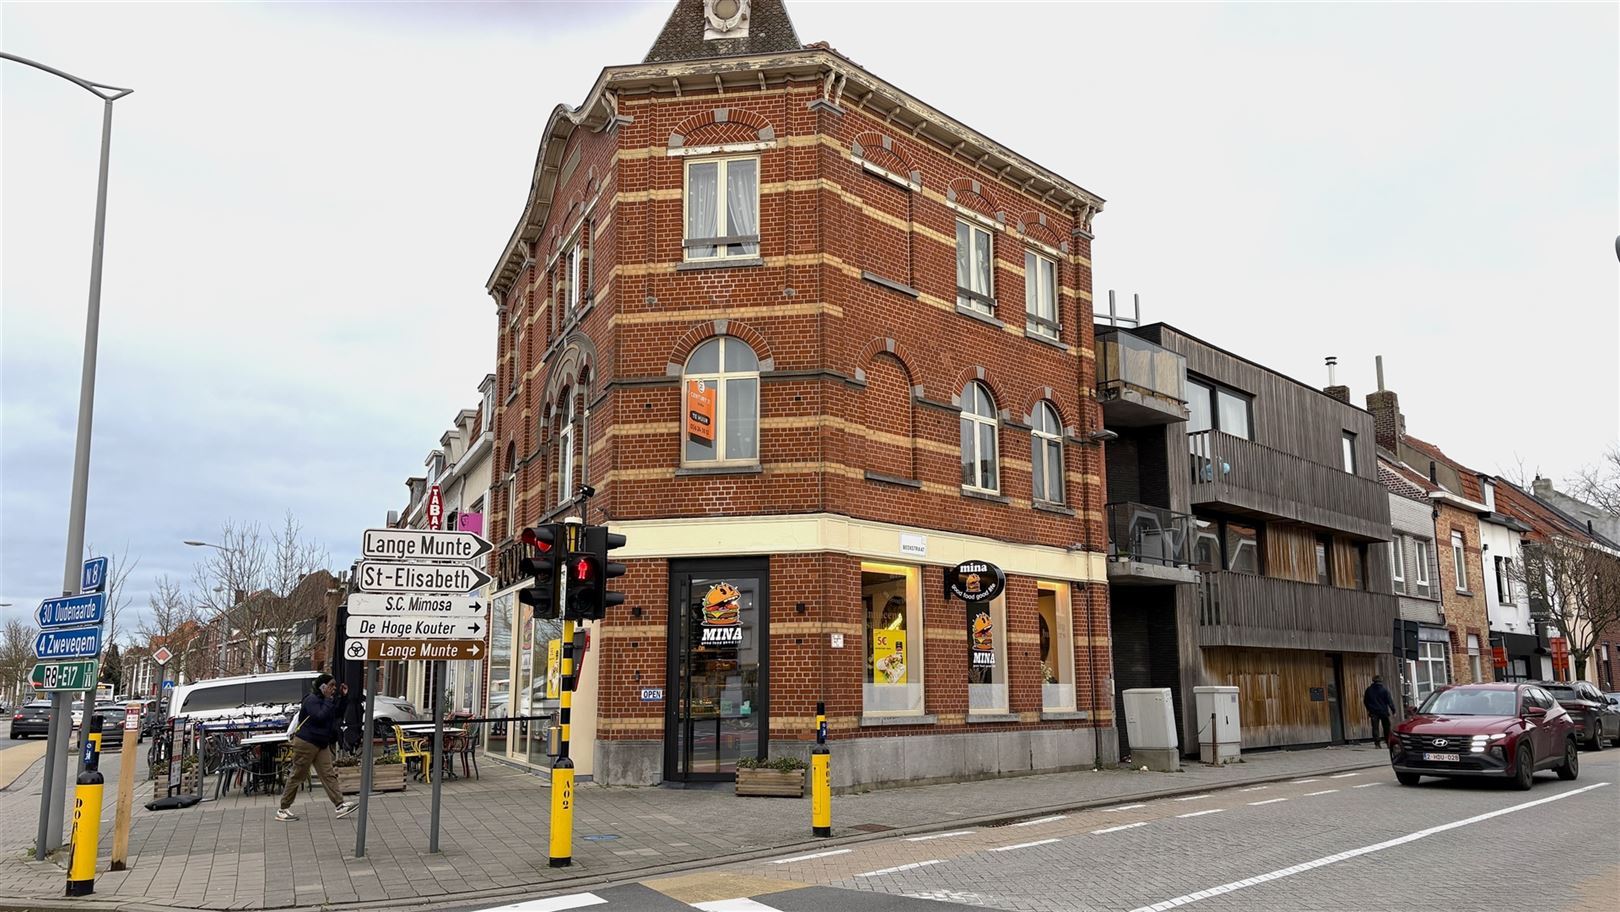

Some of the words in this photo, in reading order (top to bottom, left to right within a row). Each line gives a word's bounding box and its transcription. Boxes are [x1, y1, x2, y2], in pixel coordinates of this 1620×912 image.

[366, 534, 415, 558] Lange
[421, 536, 472, 556] Munte
[86, 569, 92, 585] N
[92, 563, 98, 584] 8
[960, 562, 987, 573] mina
[364, 566, 469, 589] St-Elisabeth
[951, 583, 963, 597] good
[963, 592, 975, 600] food
[975, 589, 989, 600] good
[42, 604, 51, 623] 30
[55, 599, 96, 622] Oudenaarde
[385, 597, 405, 611] S.C.
[408, 597, 452, 611] Mimosa
[360, 620, 375, 634] De
[381, 620, 411, 637] Hoge
[415, 621, 456, 634] Kouter
[701, 627, 743, 641] MINA
[39, 636, 45, 653] 4
[48, 634, 95, 657] Zwevegem
[877, 636, 887, 646] 5€
[379, 643, 416, 660] Lange
[420, 644, 458, 657] Munte
[973, 652, 996, 664] MINA
[643, 690, 661, 699] OPEN
